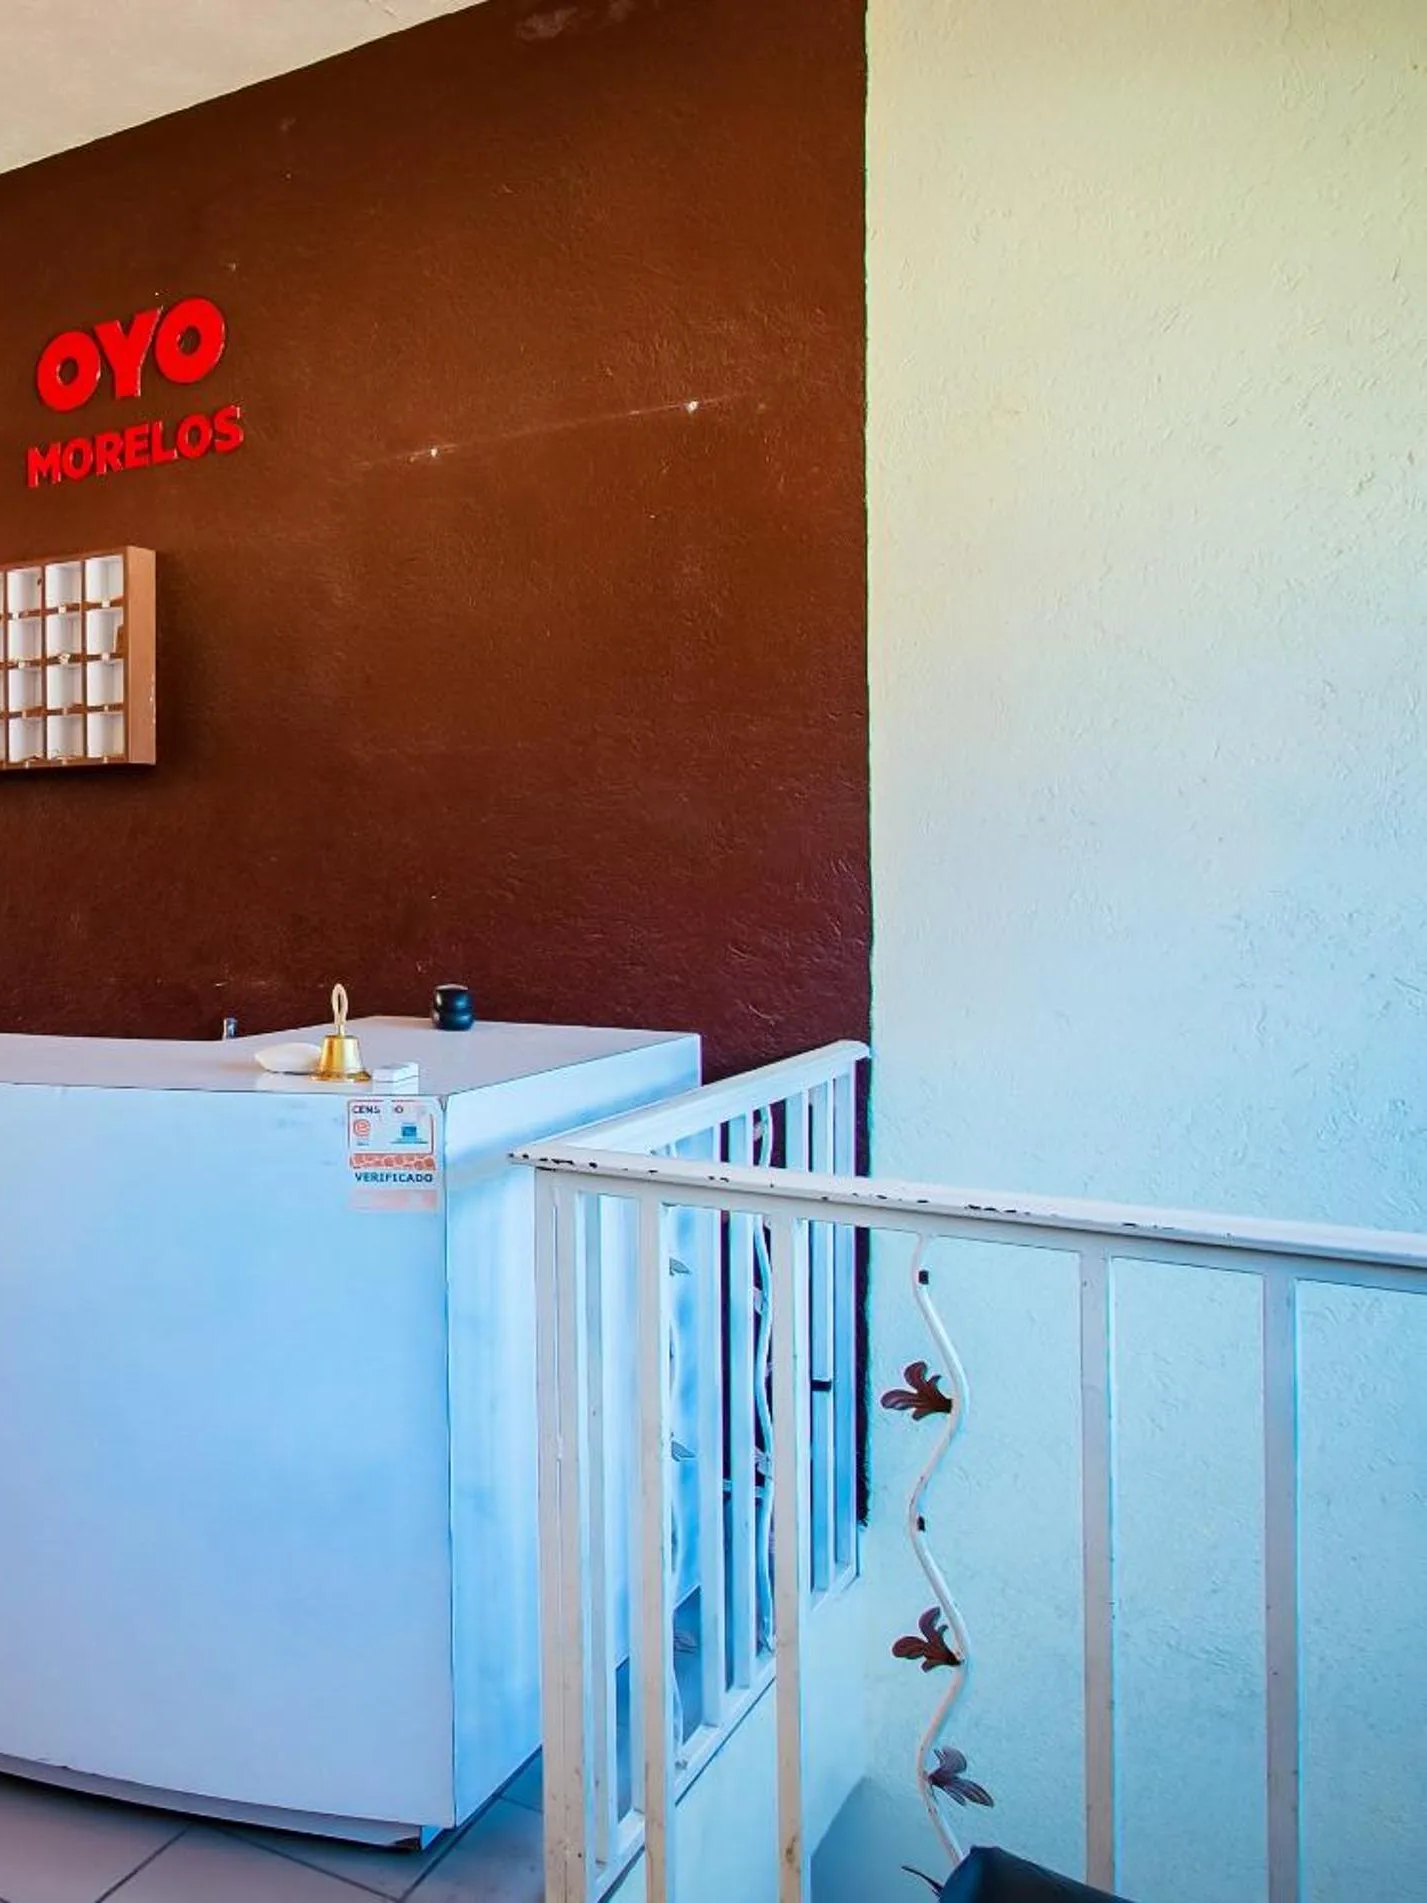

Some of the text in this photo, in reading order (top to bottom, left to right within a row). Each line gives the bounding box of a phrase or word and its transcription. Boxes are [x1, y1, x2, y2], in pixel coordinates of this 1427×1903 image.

[36, 296, 227, 412] OYO
[27, 404, 244, 488] MORELOS
[354, 1172, 433, 1182] VERIFICADO
